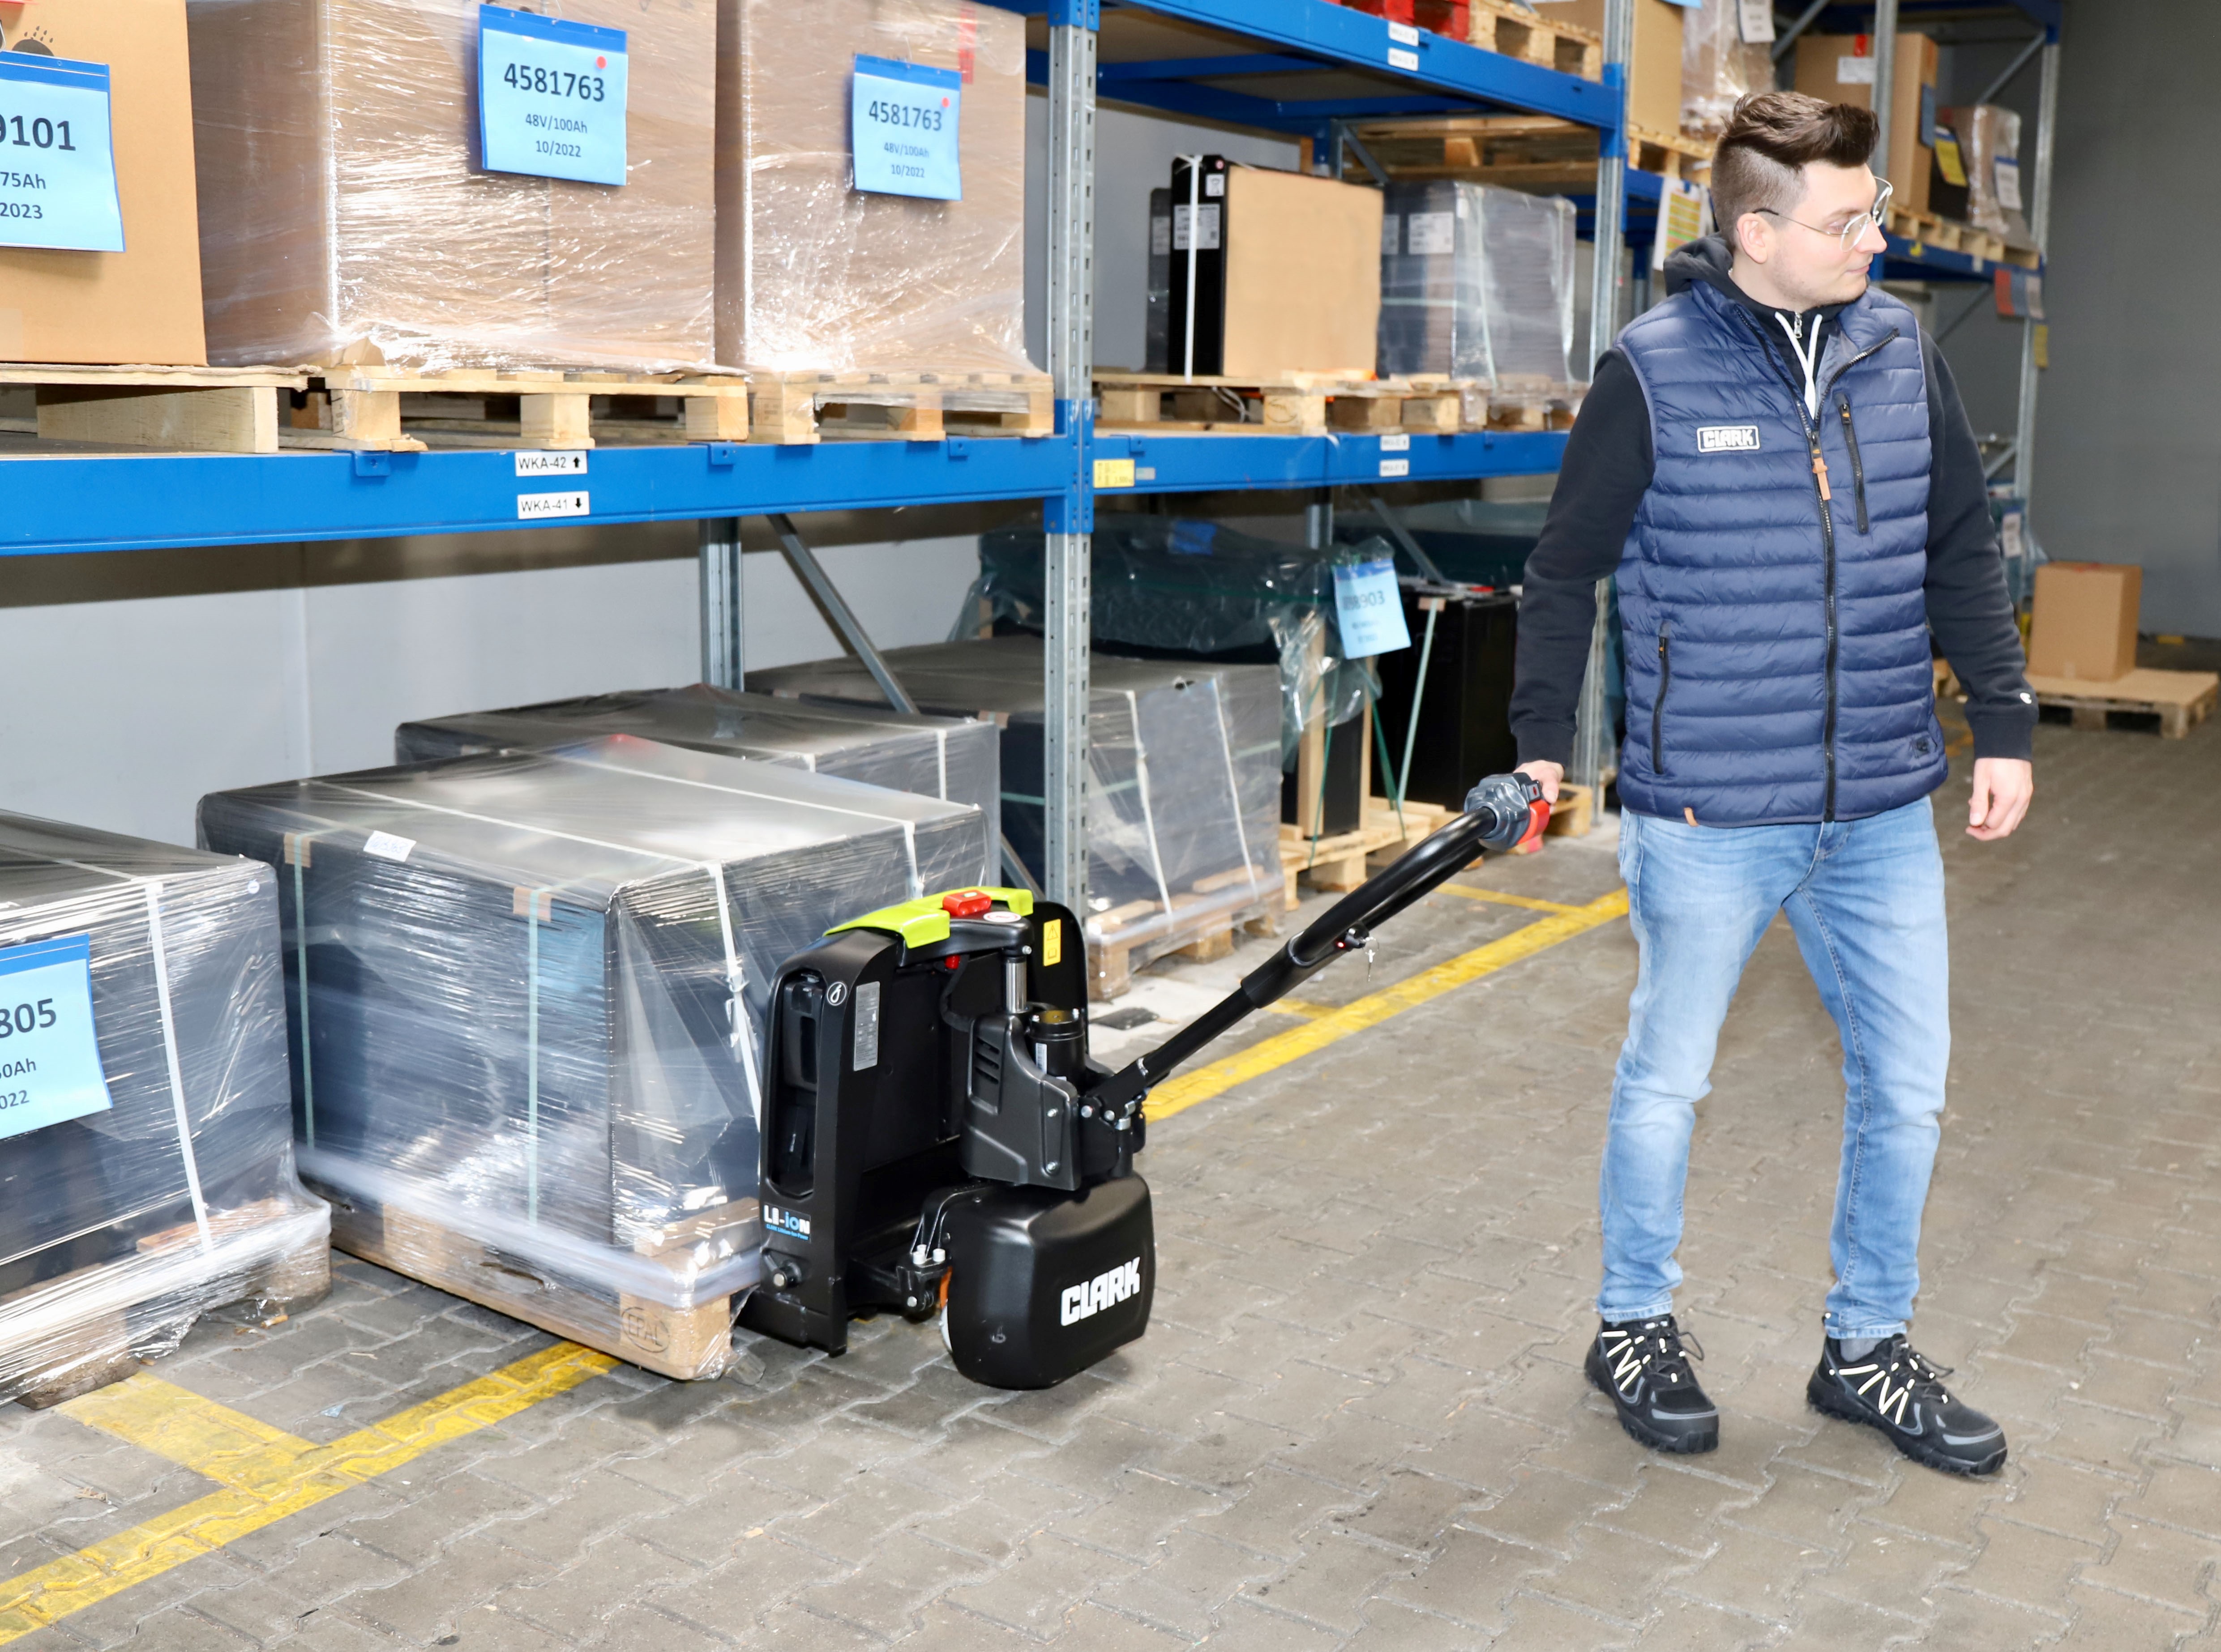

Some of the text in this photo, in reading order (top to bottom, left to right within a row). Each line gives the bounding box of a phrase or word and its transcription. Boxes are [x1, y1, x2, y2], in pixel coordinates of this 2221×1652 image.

[504, 63, 605, 102] 4581763
[525, 113, 588, 134] 48V/100Ah
[869, 100, 942, 131] 4581763
[535, 140, 582, 158] 10/2022
[884, 142, 930, 158] 48V/100Ah
[891, 164, 925, 178] 10/2022
[0, 202, 43, 219] 2023
[1703, 429, 1754, 448] CLARK
[518, 457, 566, 470] WKA-42
[521, 499, 568, 512] WKA-41
[0, 1058, 37, 1080] 0Ah
[1060, 1256, 1141, 1327] CLARK
[628, 1314, 663, 1347] EPAL
